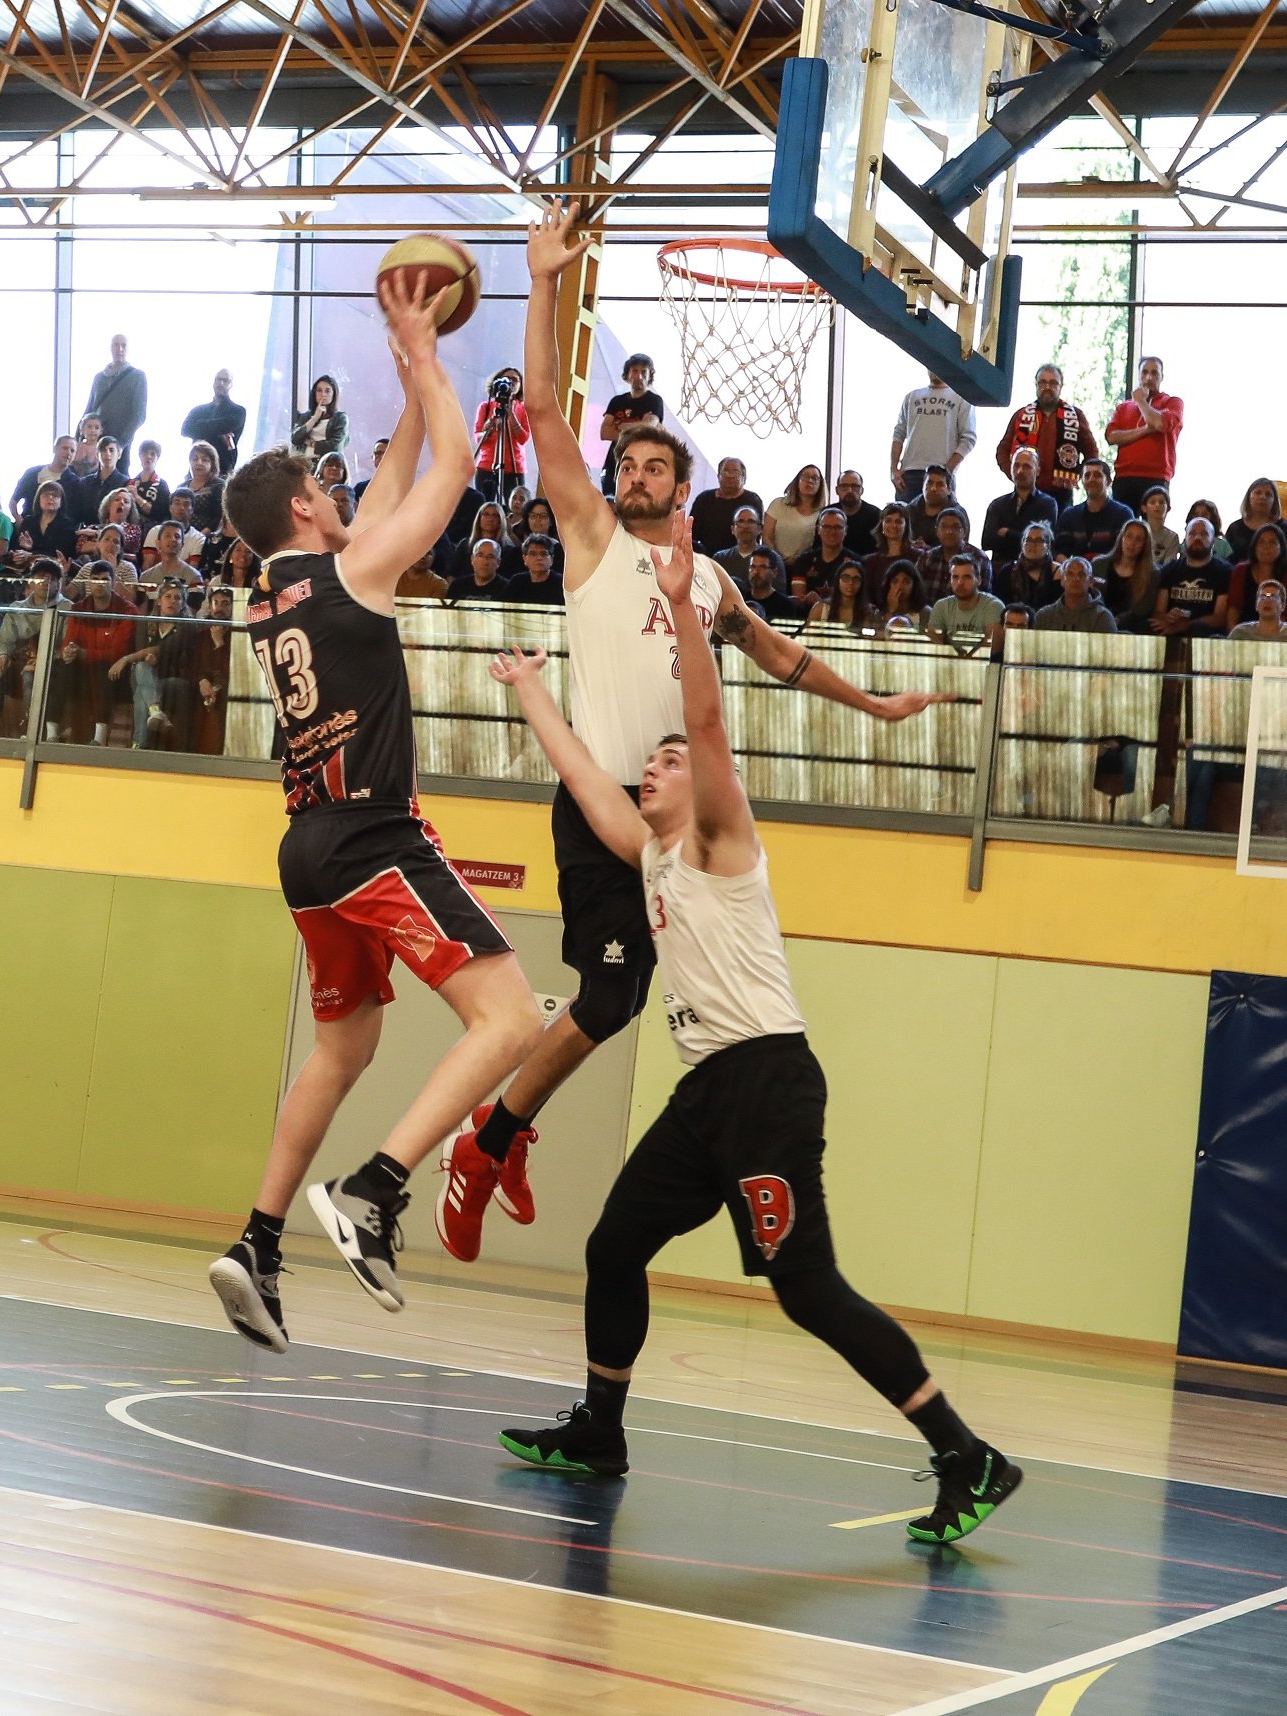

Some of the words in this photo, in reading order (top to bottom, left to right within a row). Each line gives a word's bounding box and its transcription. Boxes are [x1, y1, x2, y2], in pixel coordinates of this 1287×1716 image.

[914, 397, 956, 410] STORM
[916, 407, 947, 417] BLAST
[254, 627, 320, 729] 13
[461, 867, 511, 881] MAGATZEM
[513, 872, 520, 882] 3
